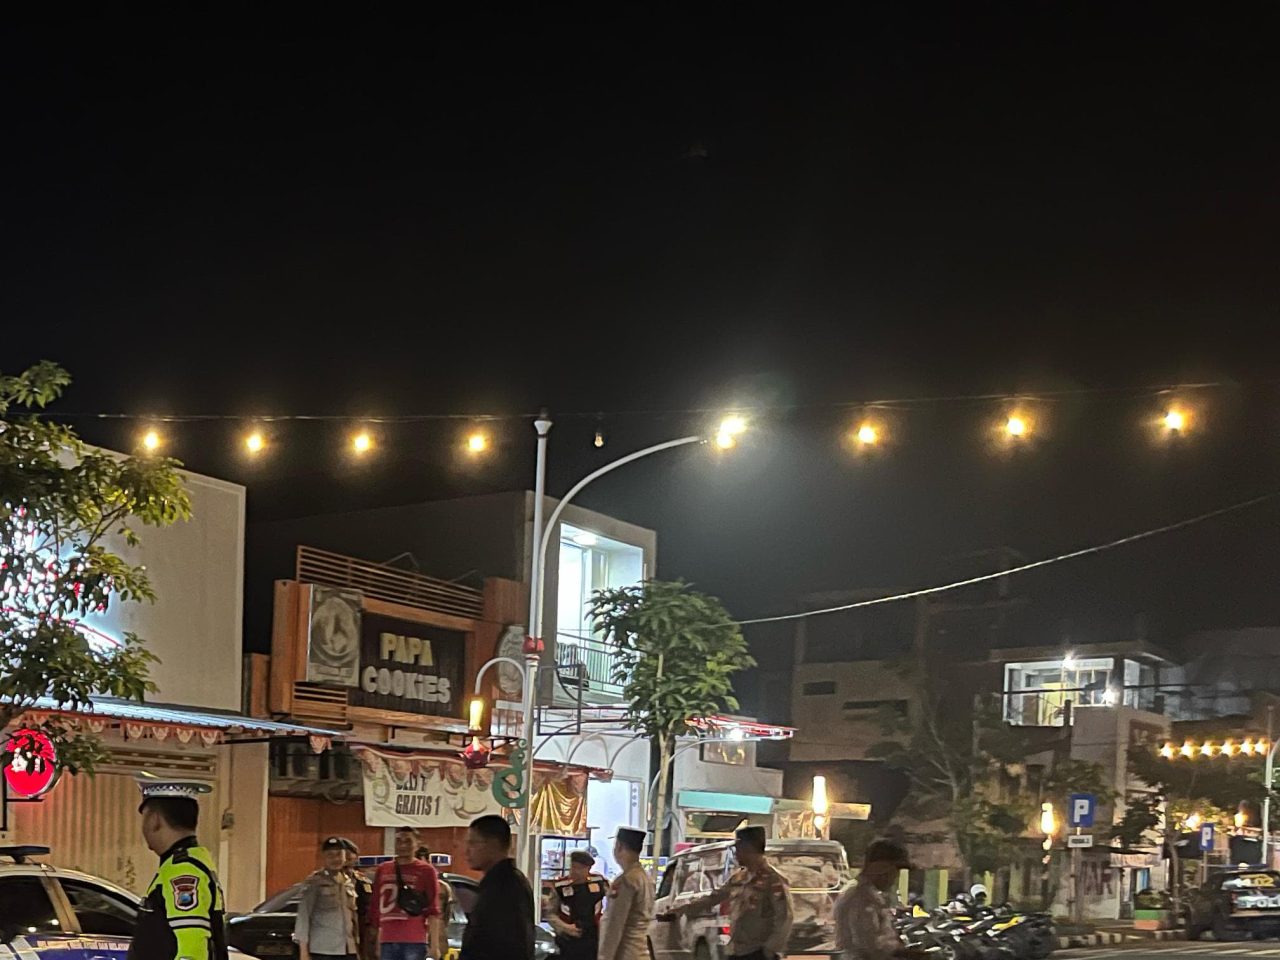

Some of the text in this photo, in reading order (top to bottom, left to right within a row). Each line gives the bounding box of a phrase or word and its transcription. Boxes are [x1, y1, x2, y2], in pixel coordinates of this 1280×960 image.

[380, 632, 433, 667] PAPA
[395, 793, 441, 816] GRATIS 1
[1074, 799, 1089, 823] P
